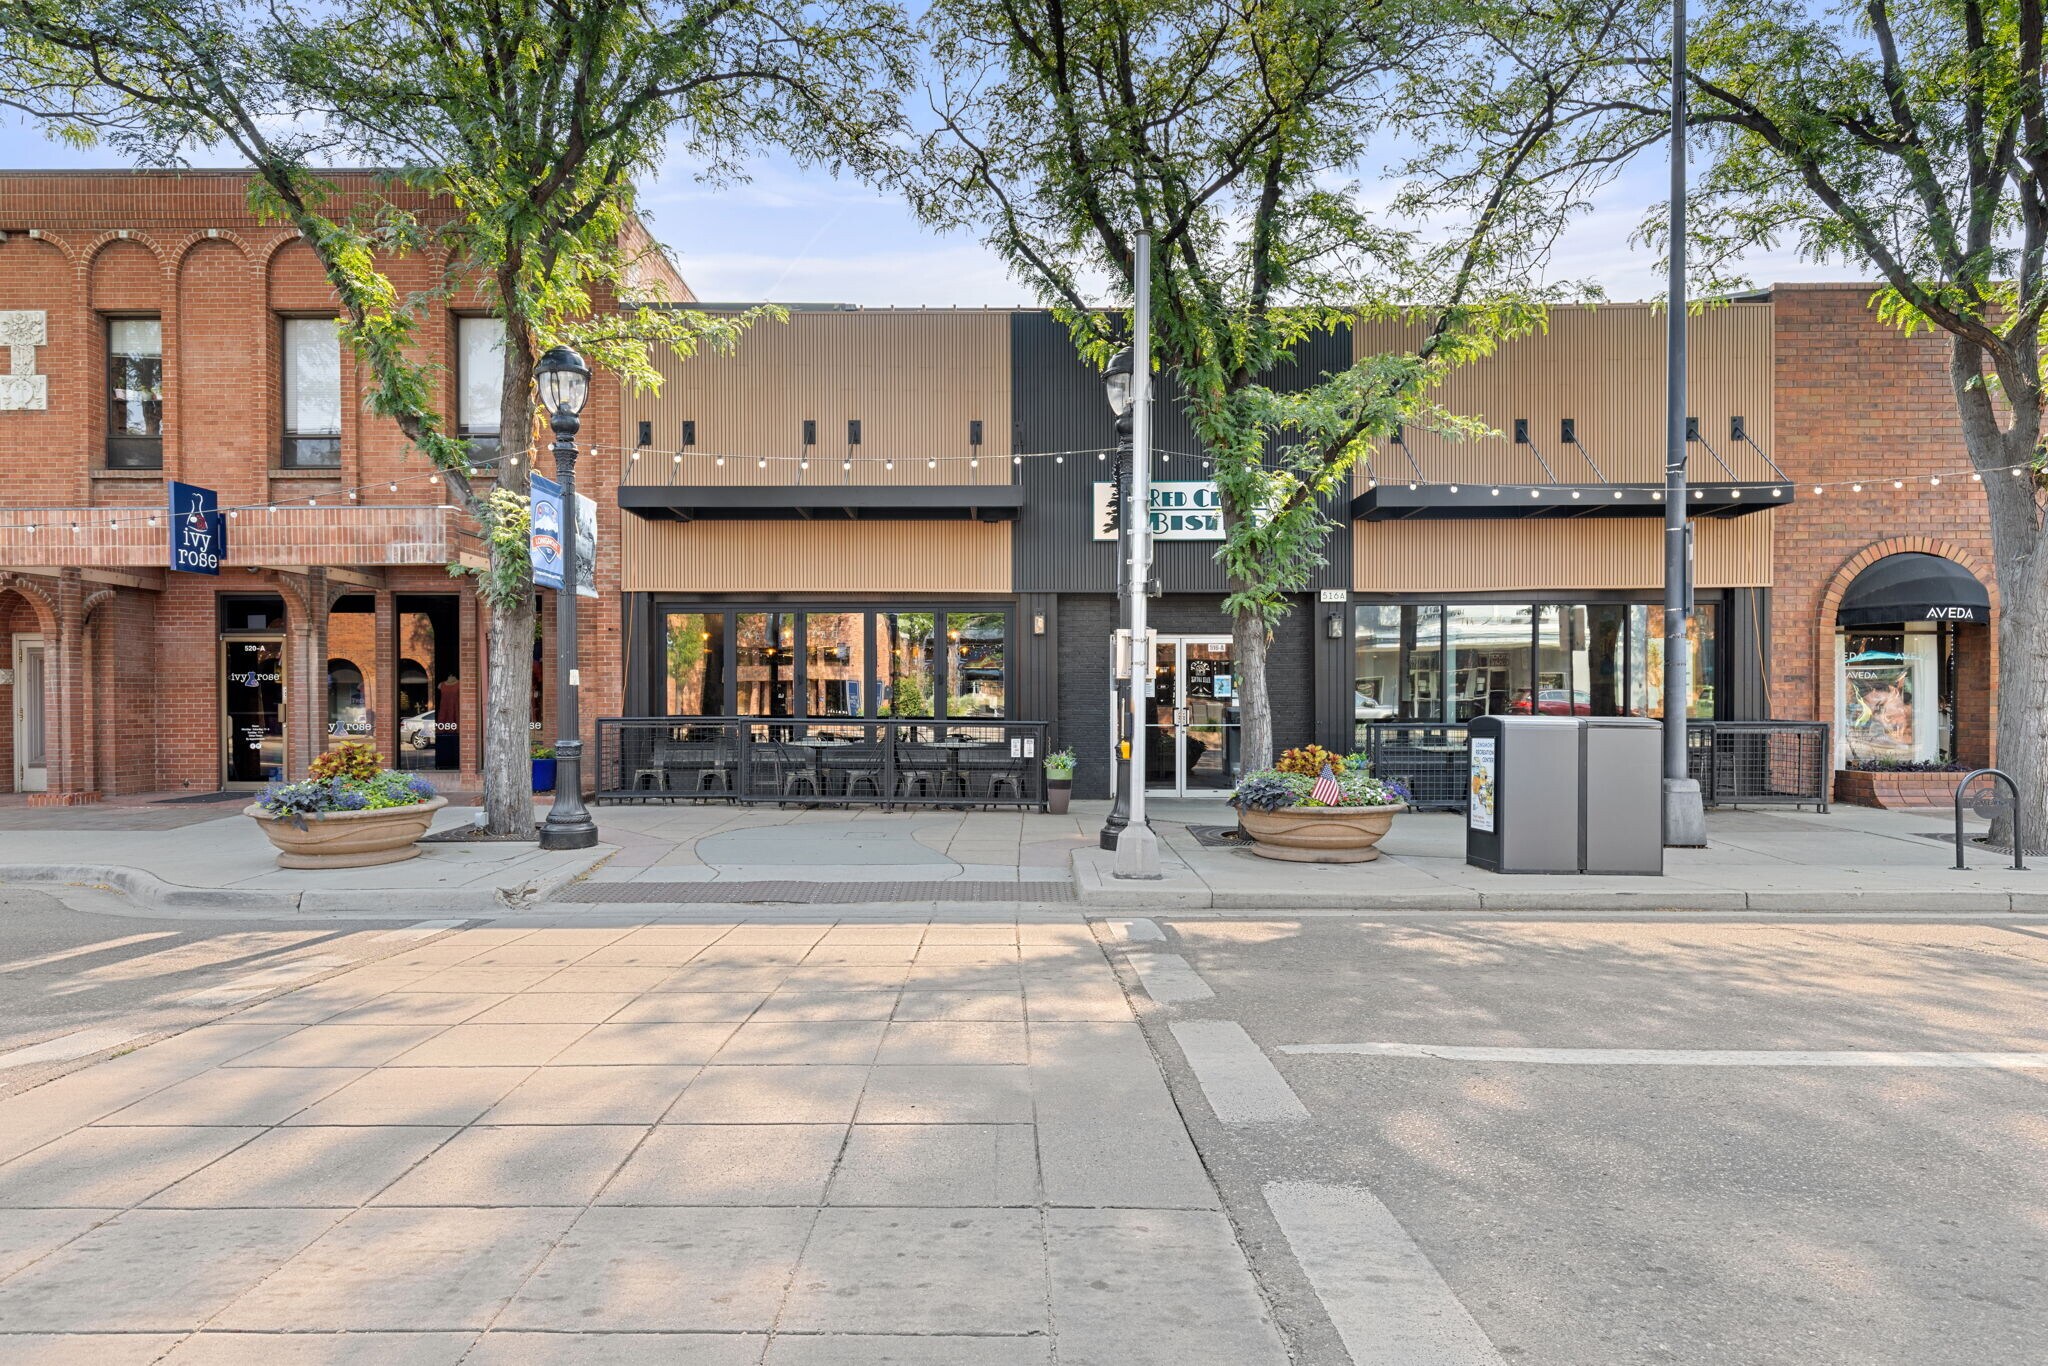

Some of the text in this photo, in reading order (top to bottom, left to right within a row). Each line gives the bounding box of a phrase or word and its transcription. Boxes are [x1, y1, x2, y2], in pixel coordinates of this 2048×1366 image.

[1150, 489, 1187, 507] RED
[183, 527, 212, 553] ivy
[178, 549, 217, 569] rose
[1322, 591, 1345, 600] 516A
[1926, 607, 1974, 619] AVEDA
[231, 672, 280, 683] ivy rose
[1846, 671, 1878, 680] AVEDA
[345, 723, 372, 731] rose
[432, 722, 458, 731] rose
[529, 721, 542, 730] se
